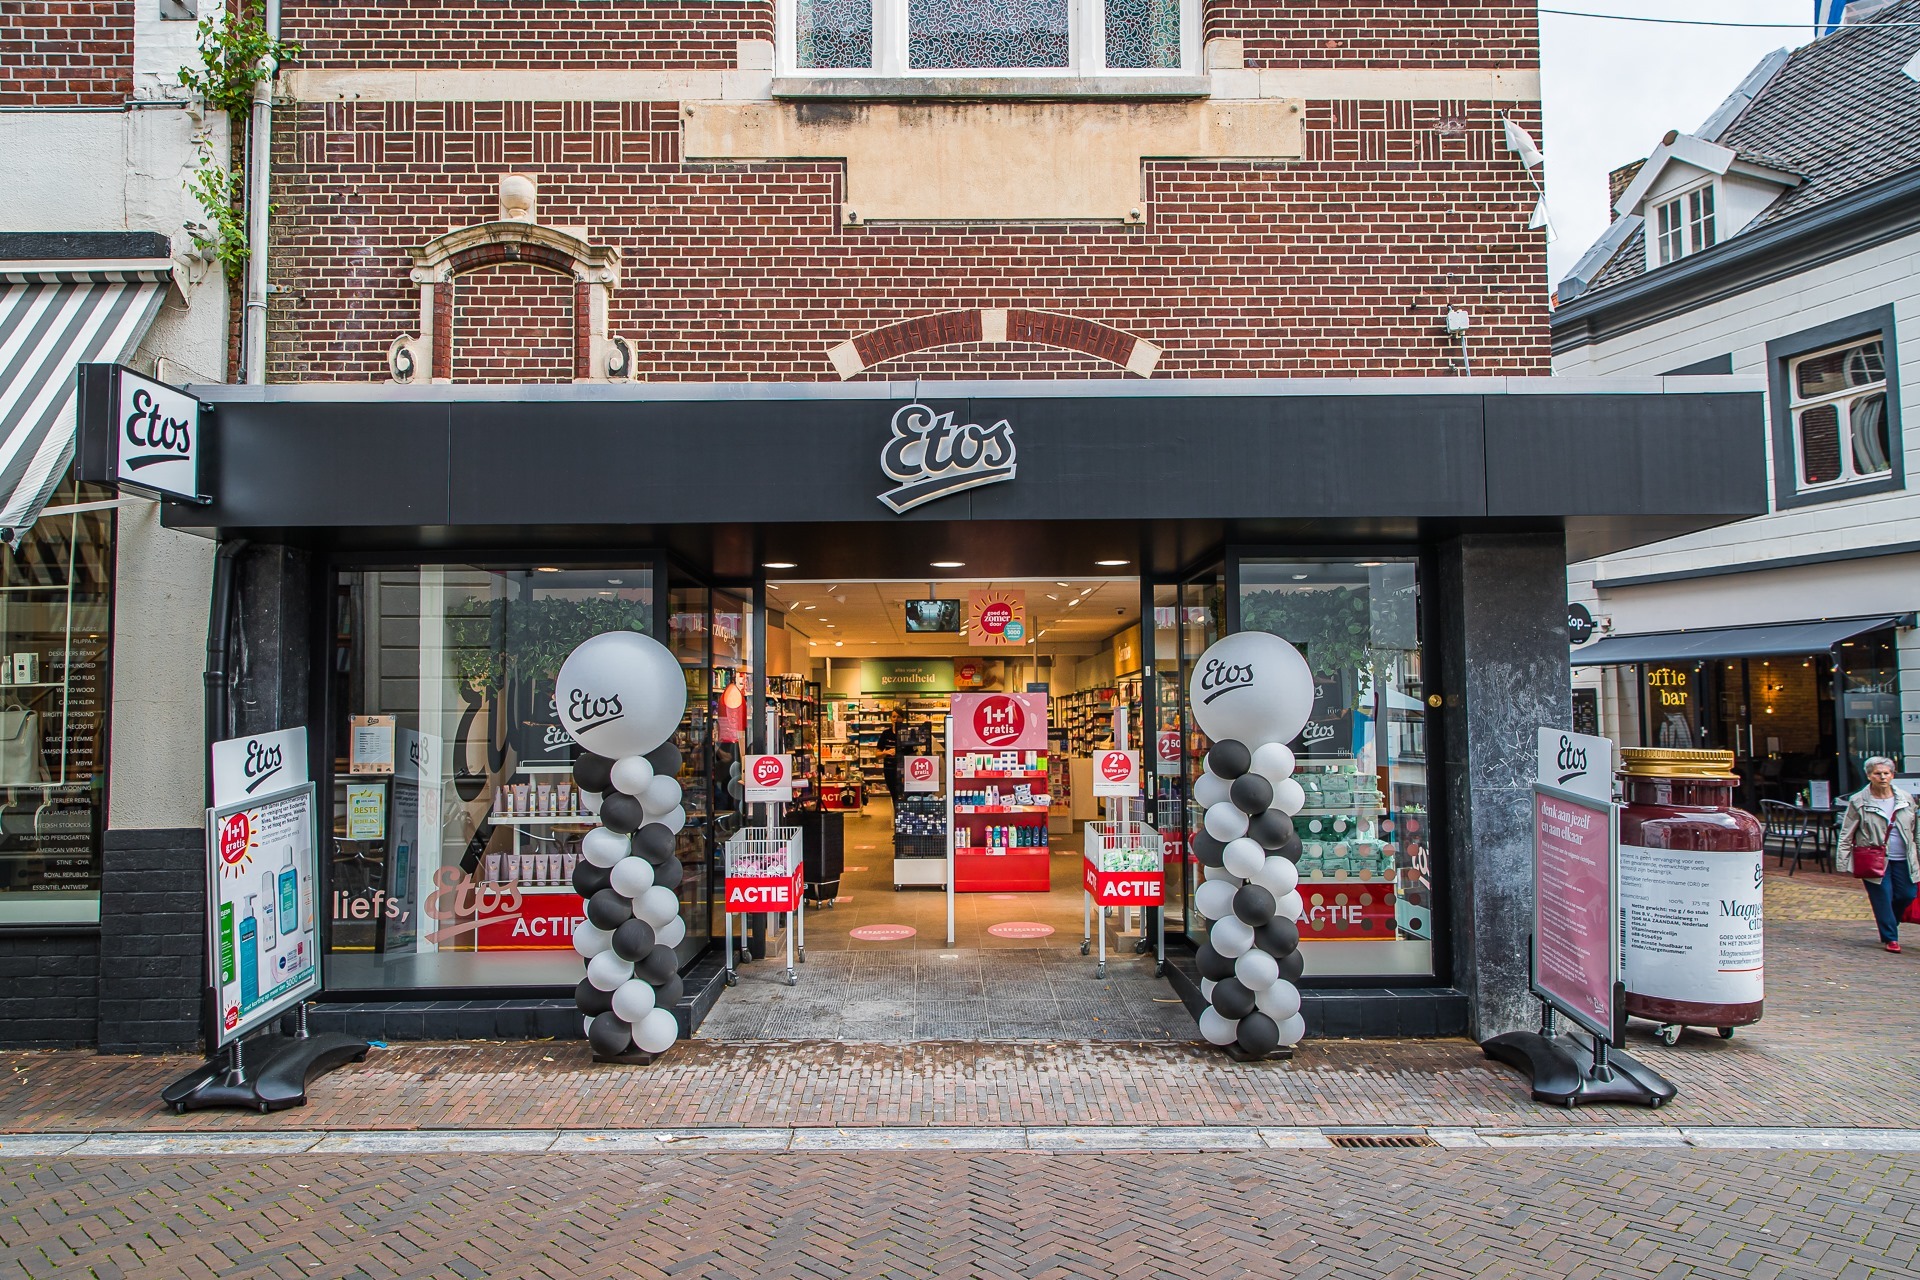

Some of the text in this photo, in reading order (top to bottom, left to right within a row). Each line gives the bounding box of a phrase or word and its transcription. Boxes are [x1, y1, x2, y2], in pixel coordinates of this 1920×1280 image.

[126, 389, 191, 453] Etos
[881, 404, 1016, 483] Etos
[881, 673, 936, 685] gezondheid
[1202, 659, 1254, 690] Etos
[1647, 669, 1686, 686] offie
[568, 688, 623, 722] Etos
[1660, 689, 1688, 706] bar
[983, 705, 1014, 725] 1+1
[983, 725, 1015, 736] gratis
[1302, 721, 1335, 738] Etos
[244, 740, 283, 777] Etos
[1557, 735, 1587, 770] Etos
[914, 761, 929, 770] 1+1
[1541, 801, 1591, 829] denk aan jezelf
[225, 818, 245, 841] 1+1
[1541, 821, 1584, 845] en aan elkaar
[225, 838, 247, 854] gratis
[1659, 863, 1690, 871] evenwichtige
[333, 890, 410, 923] liefs,
[423, 865, 523, 920] Etos
[729, 886, 789, 902] ACTIE
[1103, 881, 1161, 897] ACTIE
[1295, 905, 1363, 924] ACTIE
[1652, 918, 1680, 926] ZAANDAM,
[1654, 913, 1693, 922] Provincialeweg
[1631, 926, 1678, 937] Vitamineservicelijn
[1631, 944, 1687, 955] einde/chargenummer:
[1659, 942, 1683, 950] houdbaar
[243, 1004, 252, 1012] met
[251, 997, 265, 1008] korting
[270, 988, 279, 997] meer
[285, 975, 299, 988] 3000
